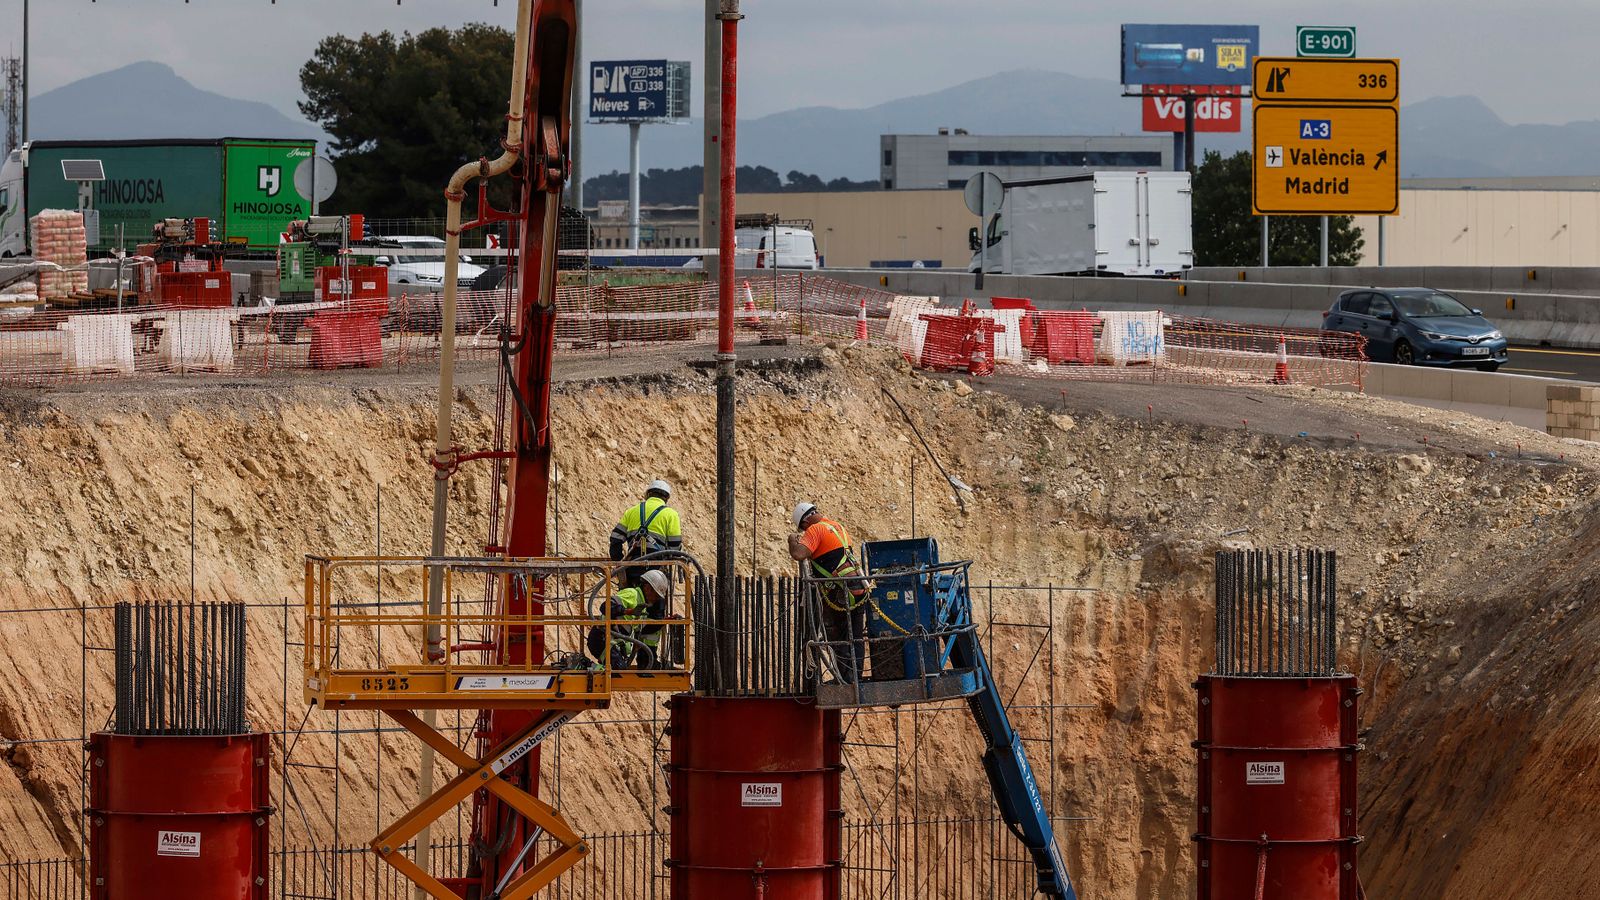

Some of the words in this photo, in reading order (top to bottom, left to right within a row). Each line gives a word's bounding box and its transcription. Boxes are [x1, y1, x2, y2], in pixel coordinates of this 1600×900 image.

[1305, 35, 1348, 50] E-901
[632, 68, 646, 76] AP7
[648, 67, 663, 77] 336
[634, 82, 644, 90] A3
[648, 81, 664, 91] 338
[1358, 74, 1388, 88] 336
[592, 97, 630, 112] Nieves
[1153, 96, 1232, 120] Vodis
[1302, 122, 1330, 137] A-3
[1290, 148, 1365, 166] València
[99, 179, 164, 205] HINOJOSA
[1286, 177, 1349, 195] Madrid
[234, 202, 302, 215] HINOJOSA
[1127, 320, 1145, 338] NO
[1123, 335, 1162, 355] PASAR
[362, 678, 409, 691] 8523
[1250, 763, 1281, 773] Alsina
[745, 784, 778, 795] Alsina
[161, 832, 196, 844] Alsina
